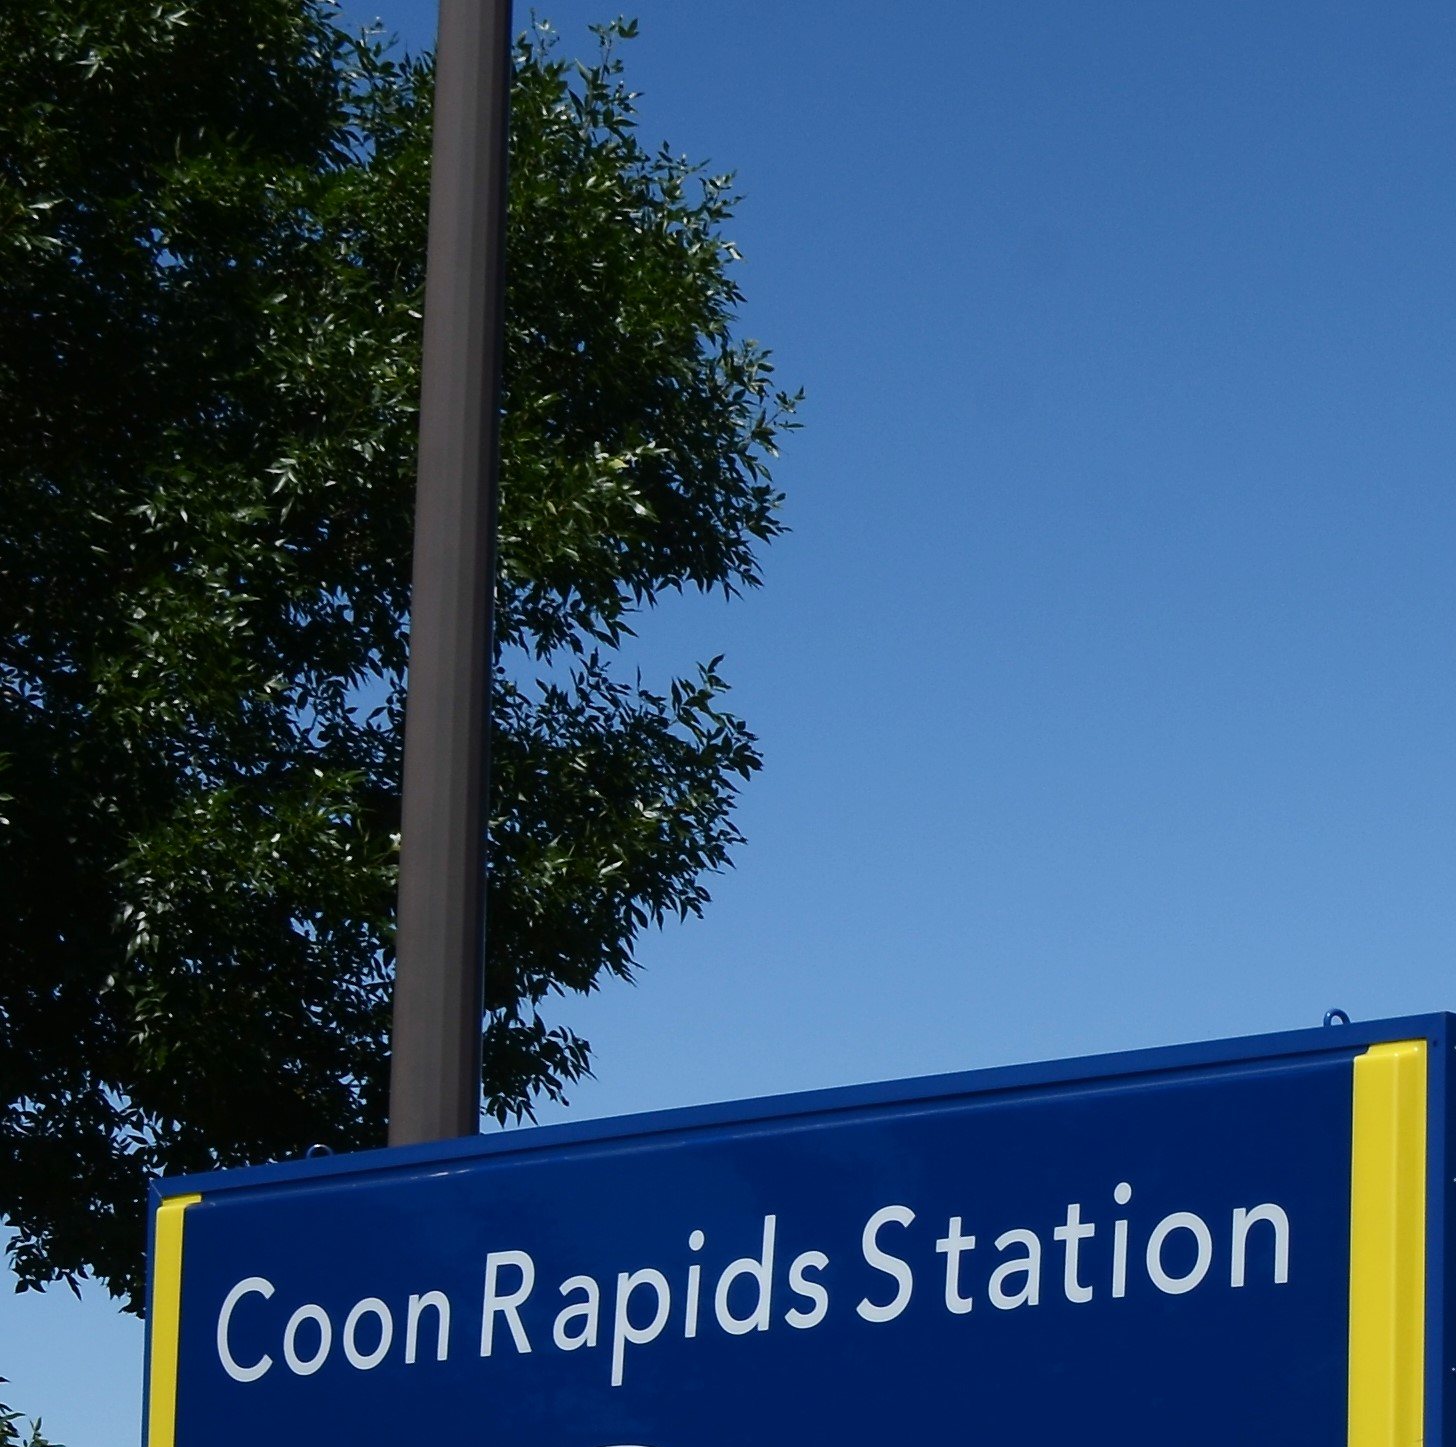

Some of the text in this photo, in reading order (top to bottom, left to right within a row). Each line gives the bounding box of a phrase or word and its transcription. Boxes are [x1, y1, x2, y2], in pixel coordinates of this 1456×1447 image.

[217, 1182, 1290, 1386] Coon Rapids Station
